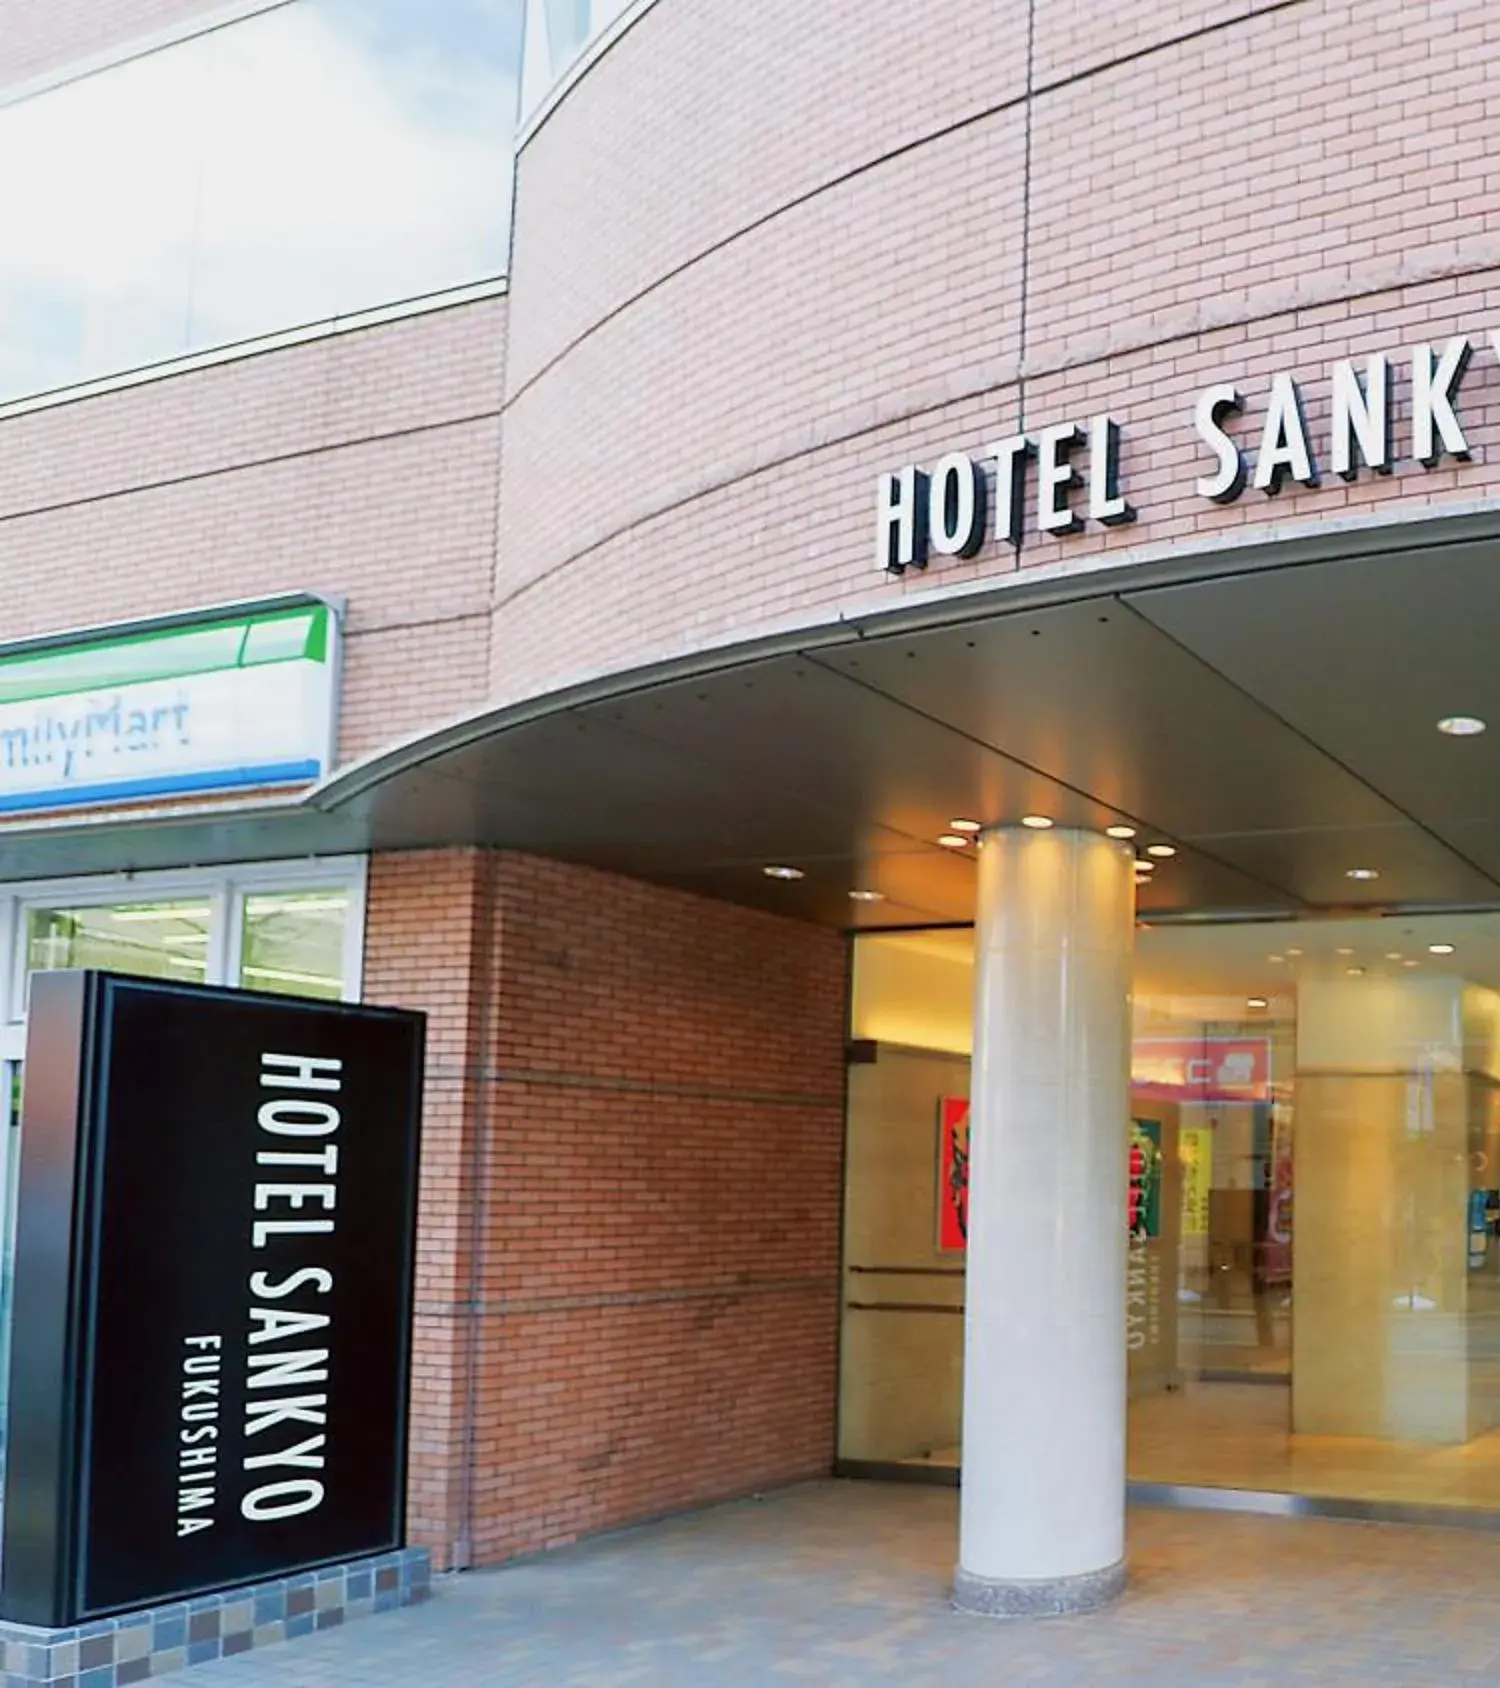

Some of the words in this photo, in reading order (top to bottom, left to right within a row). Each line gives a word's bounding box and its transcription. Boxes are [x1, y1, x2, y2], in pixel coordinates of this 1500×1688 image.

[875, 415, 1134, 573] HOTEL
[253, 1053, 342, 1248] HOTEL
[178, 1335, 222, 1537] FUKUSHIMA
[241, 1267, 333, 1521] SANKYO
